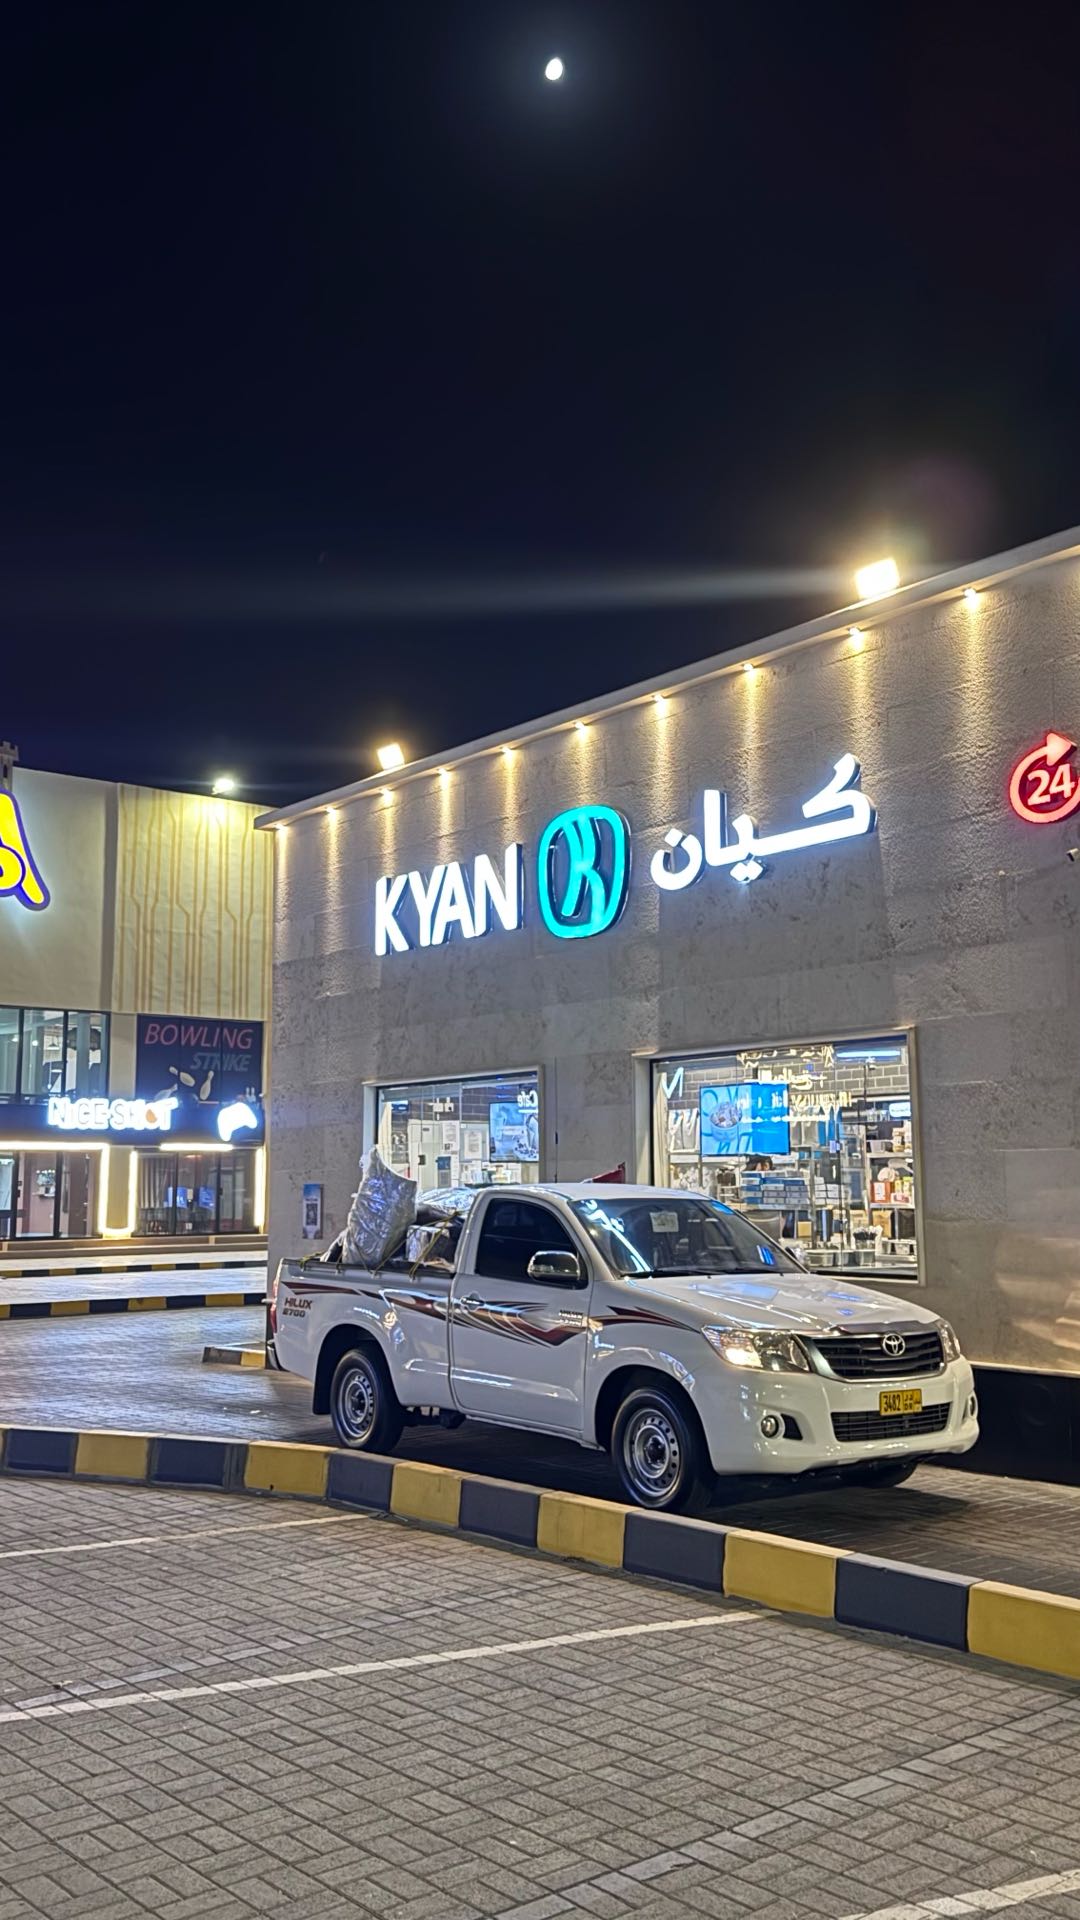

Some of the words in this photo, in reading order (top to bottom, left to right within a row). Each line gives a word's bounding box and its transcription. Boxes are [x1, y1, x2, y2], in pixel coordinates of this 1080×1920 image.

[1027, 763, 1076, 806] 24
[650, 753, 874, 891] كيان
[375, 842, 520, 957] KYAN
[144, 1023, 254, 1050] BOWLING
[190, 1052, 252, 1072] STRIKE
[284, 1297, 313, 1311] HILUX
[883, 1393, 901, 1412] 3482
